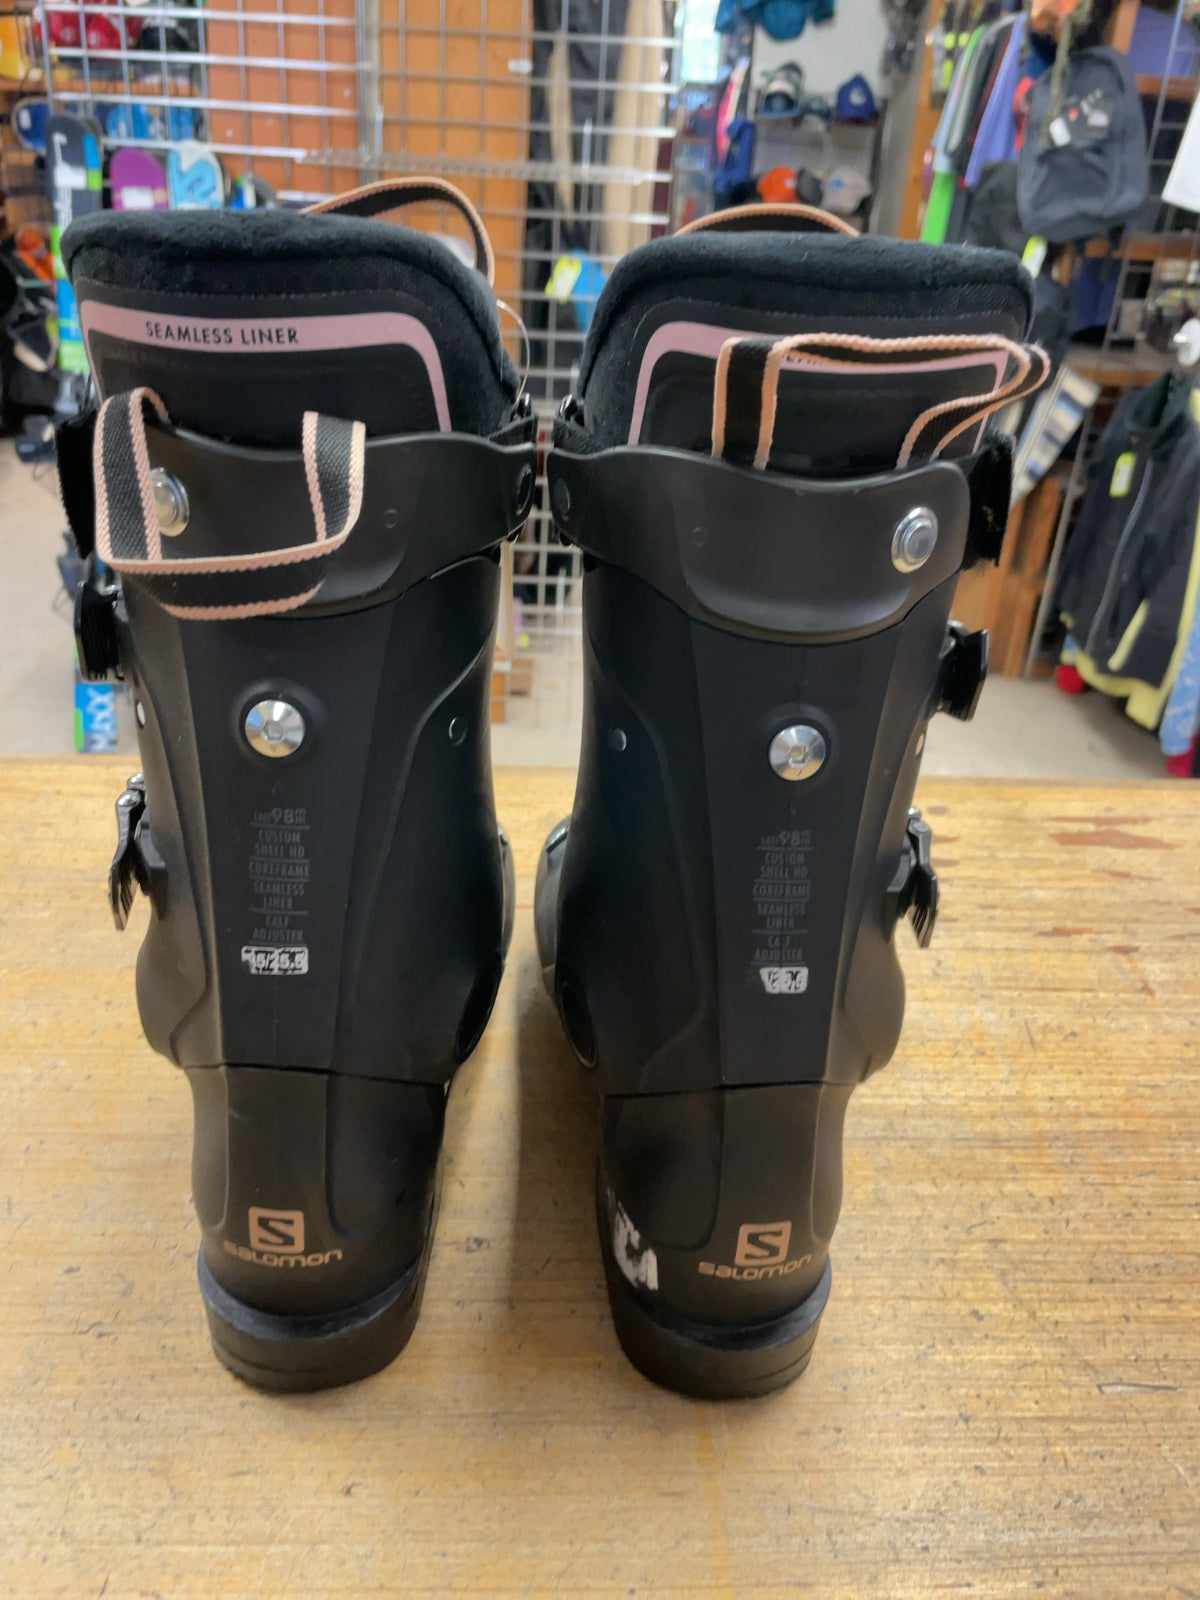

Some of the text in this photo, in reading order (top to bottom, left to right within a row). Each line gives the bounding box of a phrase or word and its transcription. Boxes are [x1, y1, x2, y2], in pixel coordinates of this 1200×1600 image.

[146, 321, 299, 344] SEAMLESS LINER
[258, 829, 301, 843] CUSTOM
[254, 843, 285, 858] SHELL
[764, 852, 805, 865] CUSTOM
[249, 862, 310, 877] COREFRAME
[760, 865, 790, 878] SHELL
[253, 881, 305, 897] SEAMLESS
[753, 883, 811, 898] COREFRAME
[757, 902, 805, 915] SEAMLESS
[766, 916, 794, 929] LINER
[252, 927, 304, 942] ADJUSTER
[768, 936, 792, 948] CAF
[754, 948, 803, 961] ADJUSTER
[223, 1240, 343, 1268] salomon
[698, 1253, 812, 1280] salomon
